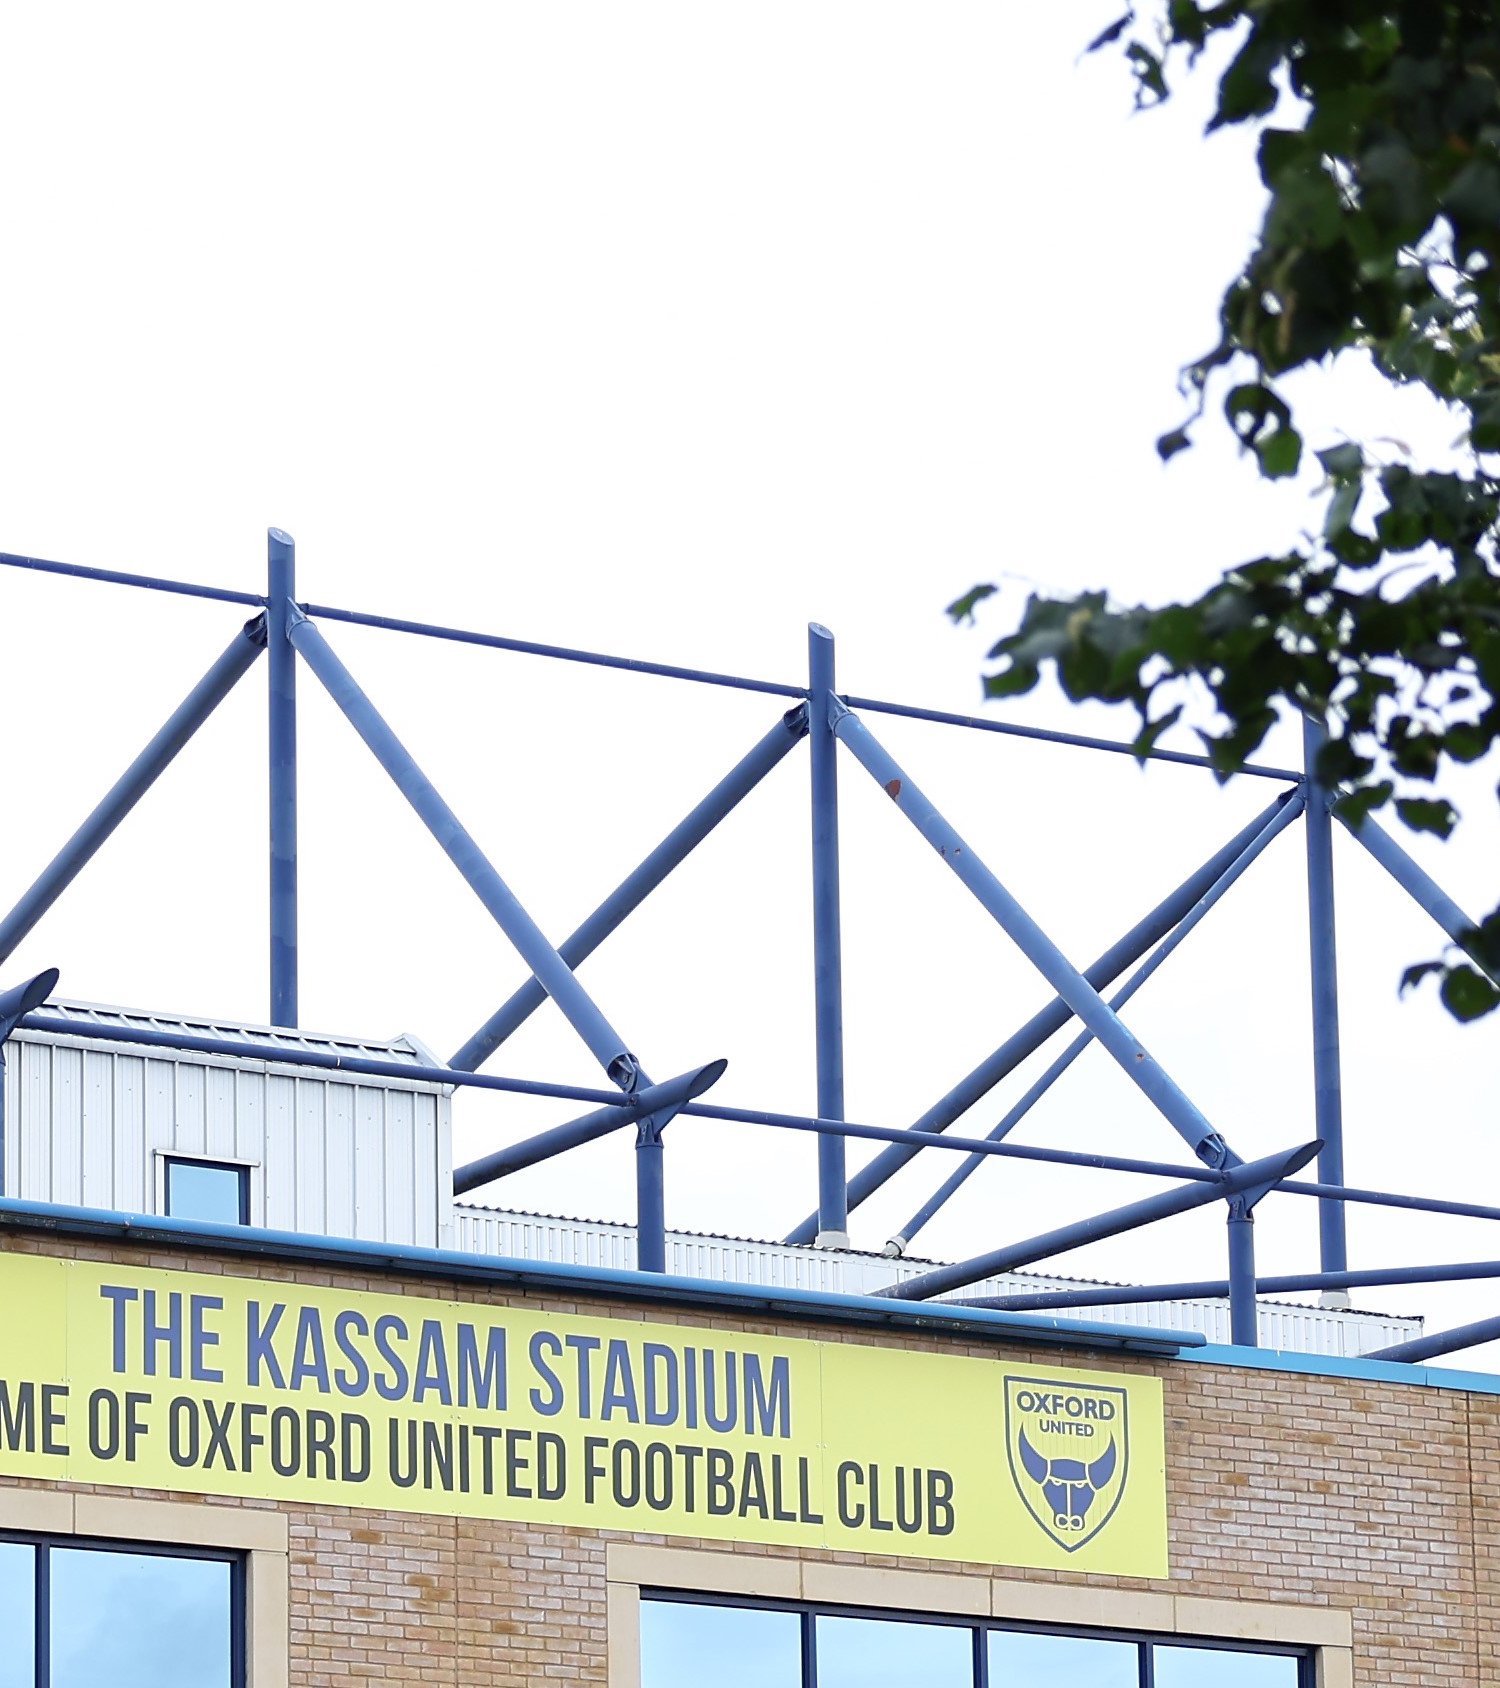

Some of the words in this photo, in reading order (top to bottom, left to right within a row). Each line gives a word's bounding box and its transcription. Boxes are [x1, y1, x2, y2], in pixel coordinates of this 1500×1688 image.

[100, 1284, 224, 1383] THE
[246, 1300, 507, 1411] KASSAM
[528, 1331, 791, 1439] STADIUM
[1016, 1390, 1115, 1421] OXFORD
[88, 1388, 152, 1462] OF
[169, 1396, 371, 1483] OXFORD
[388, 1417, 567, 1501] UNITED
[584, 1436, 824, 1525] FOOTBALL
[837, 1460, 955, 1536] CLUB
[1039, 1418, 1094, 1437] UNITED
